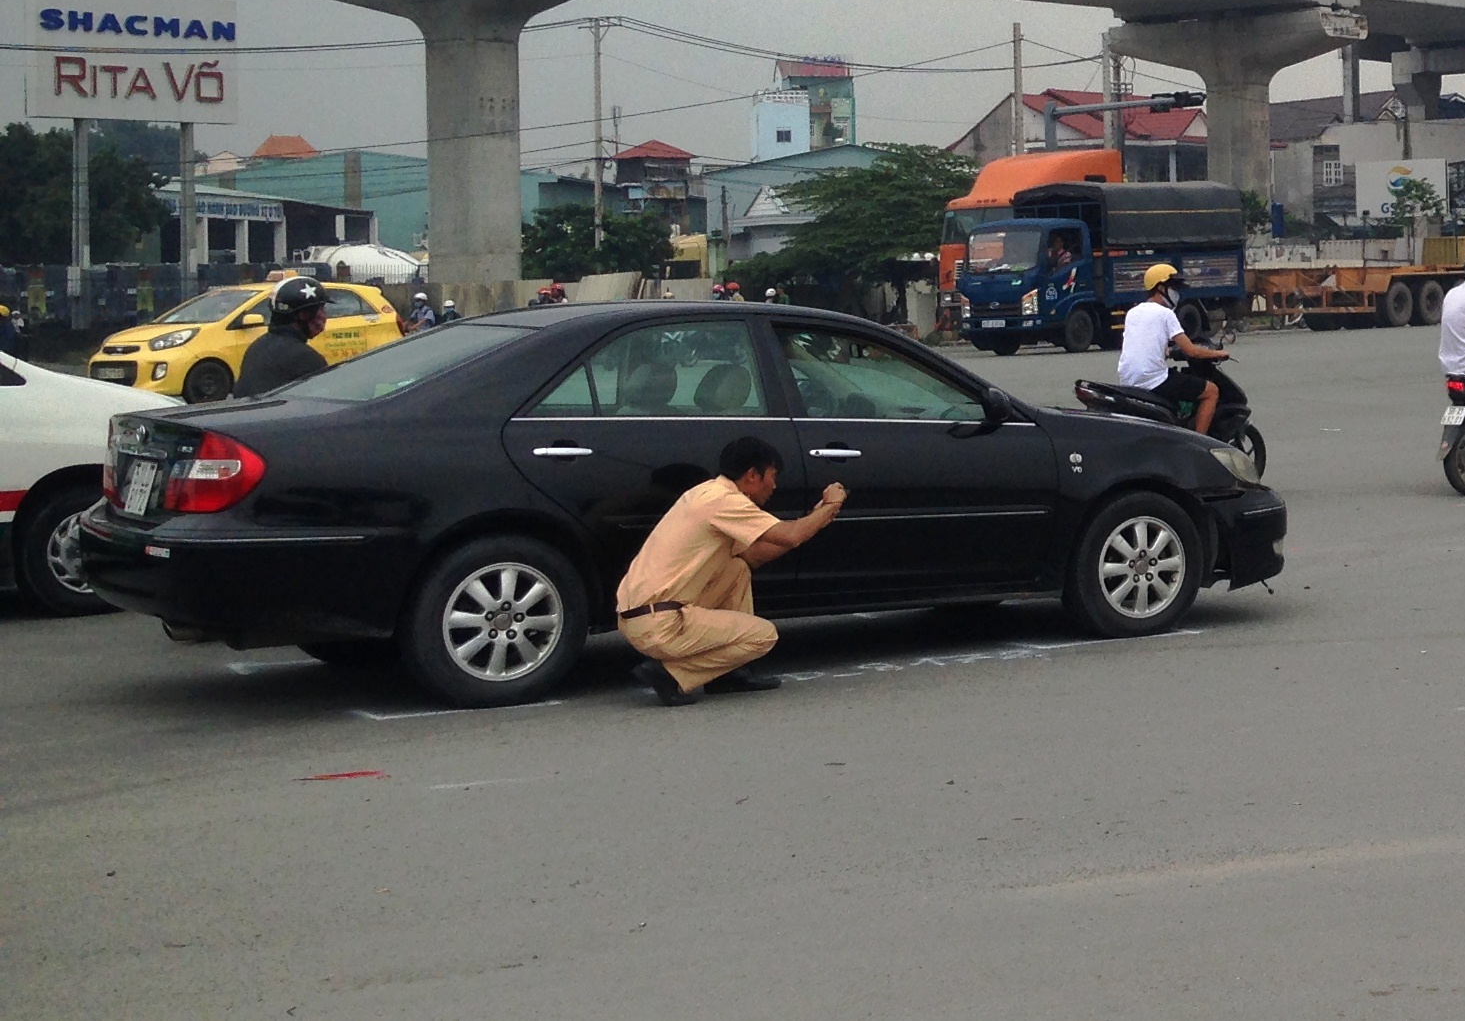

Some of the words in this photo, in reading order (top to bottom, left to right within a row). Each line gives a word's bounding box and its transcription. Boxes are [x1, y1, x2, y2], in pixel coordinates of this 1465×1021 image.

[39, 8, 236, 42] SHACMAN
[54, 56, 157, 100] RITA
[162, 60, 224, 103] VÕ
